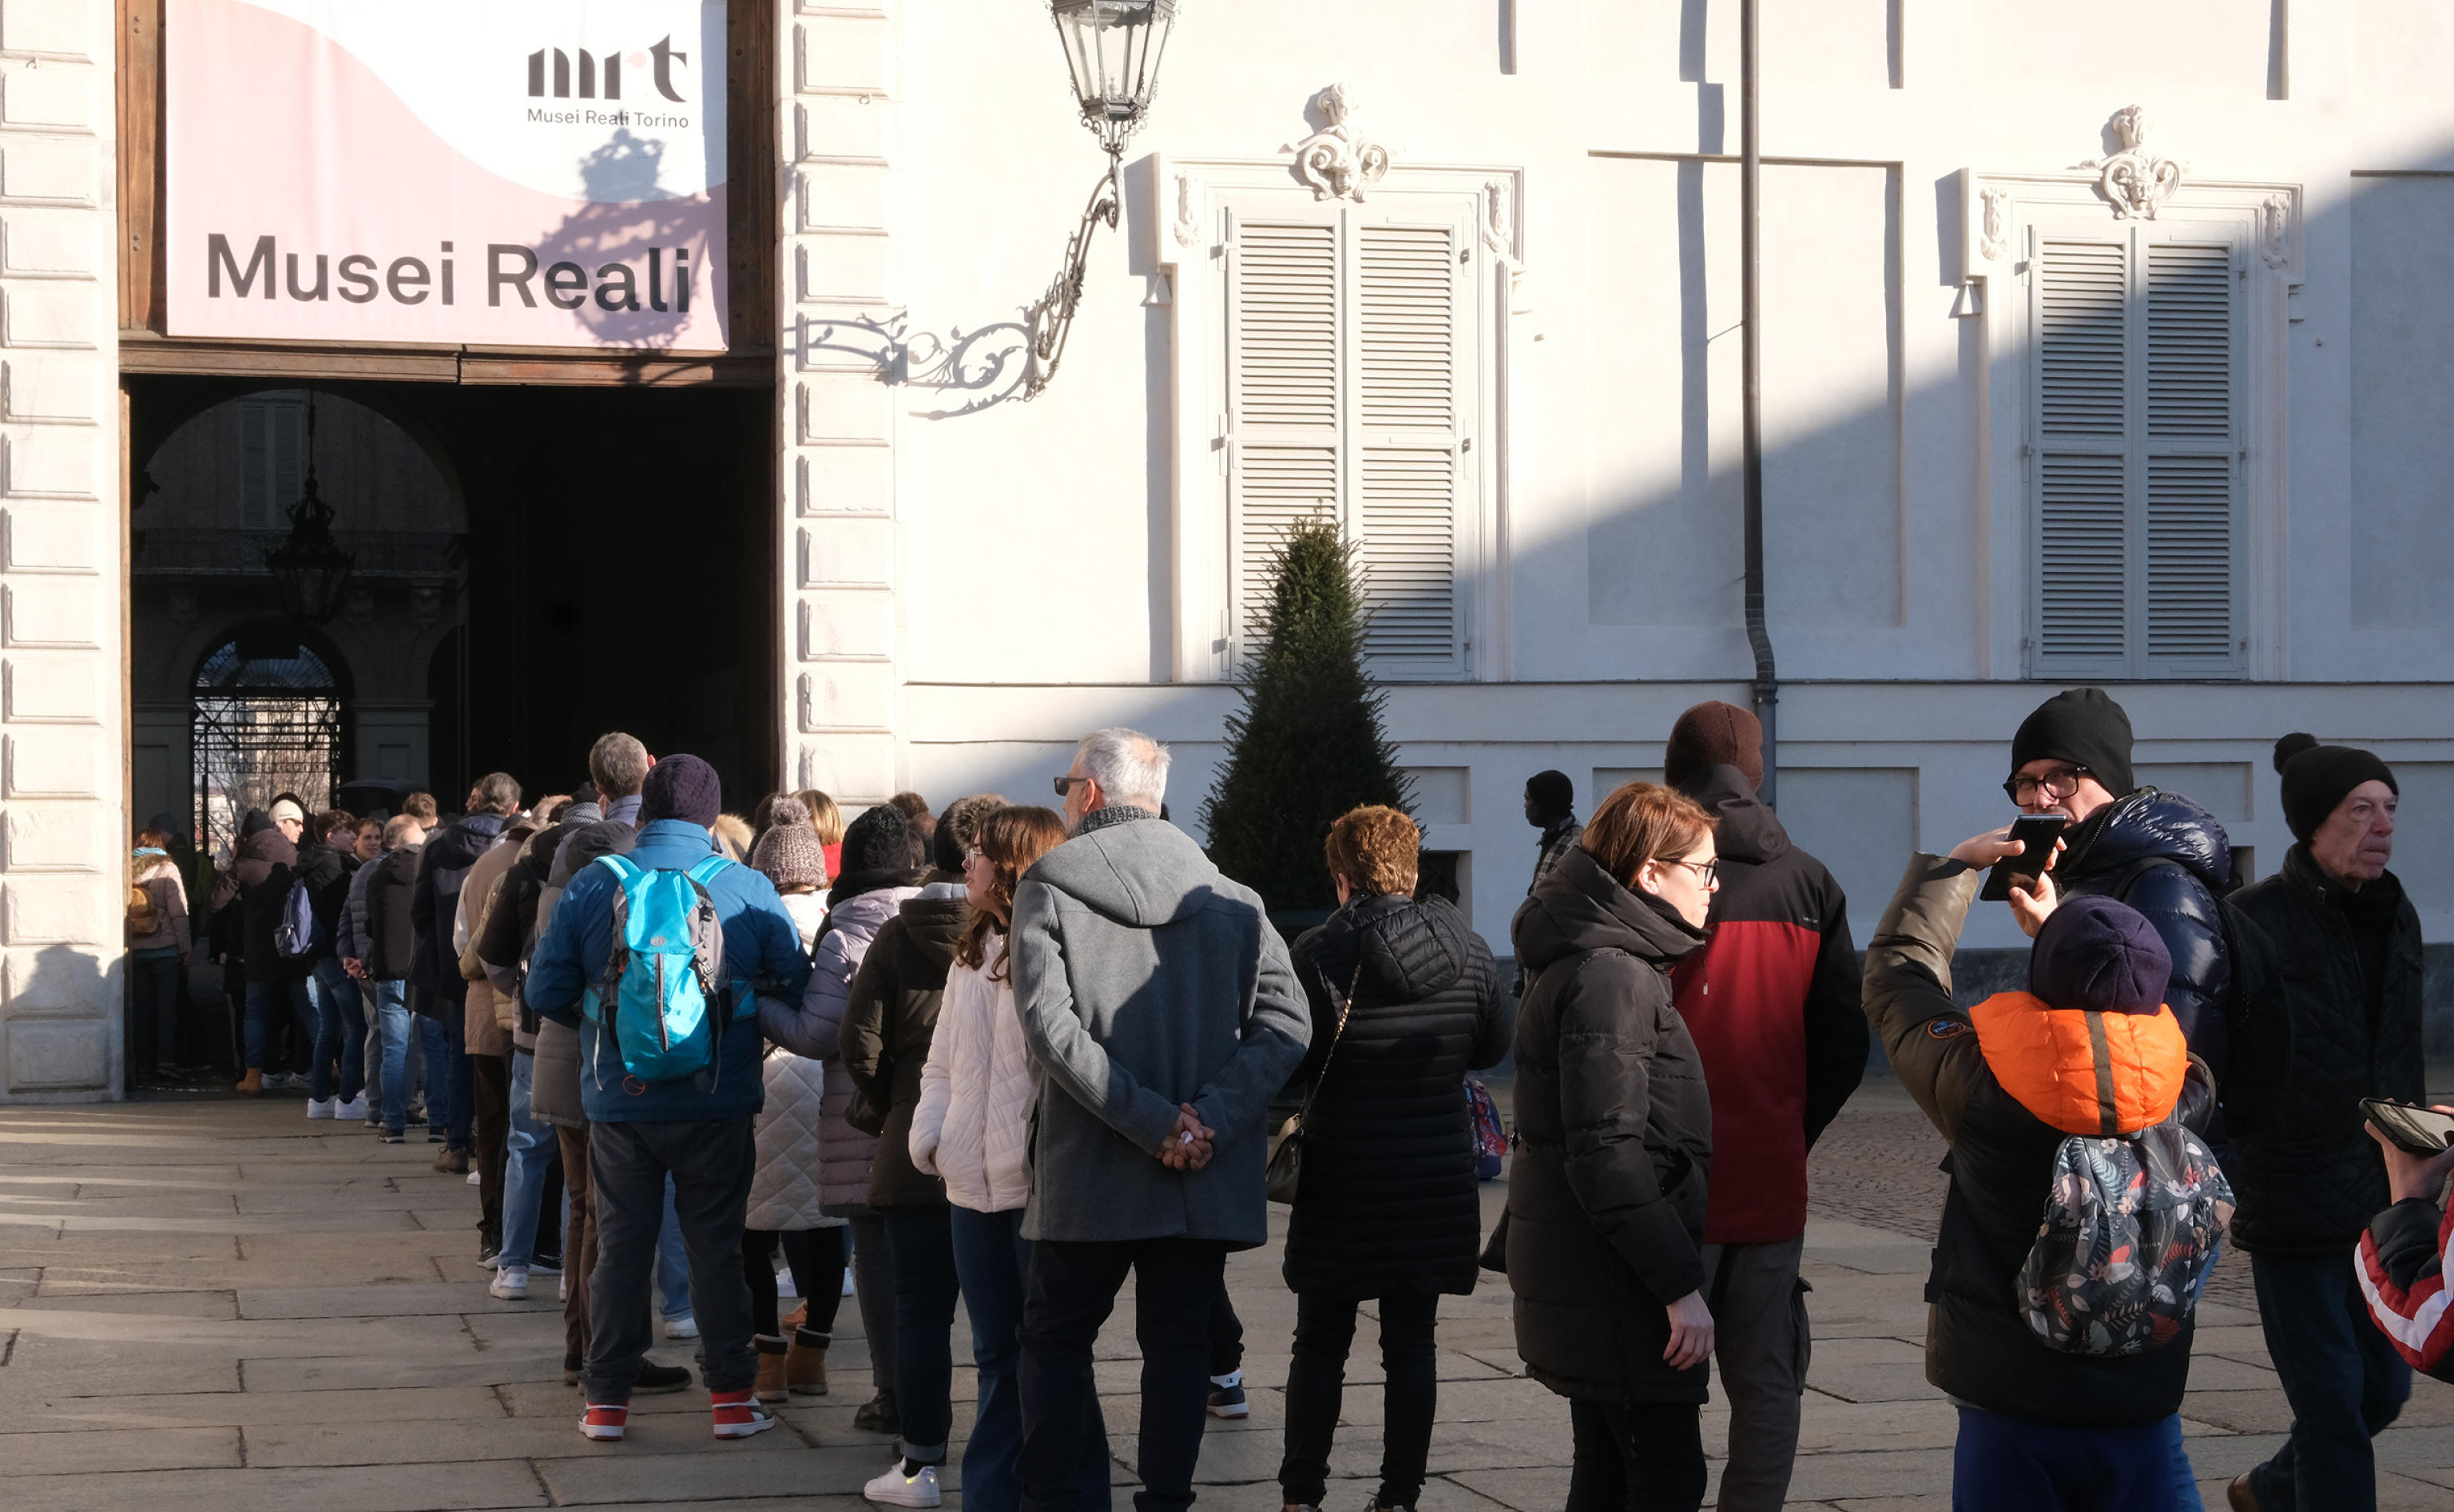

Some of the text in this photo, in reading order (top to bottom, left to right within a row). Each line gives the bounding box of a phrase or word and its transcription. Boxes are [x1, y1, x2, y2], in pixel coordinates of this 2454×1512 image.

[527, 108, 689, 128] Musei Reali Torino
[208, 233, 689, 313] Musei Reali
